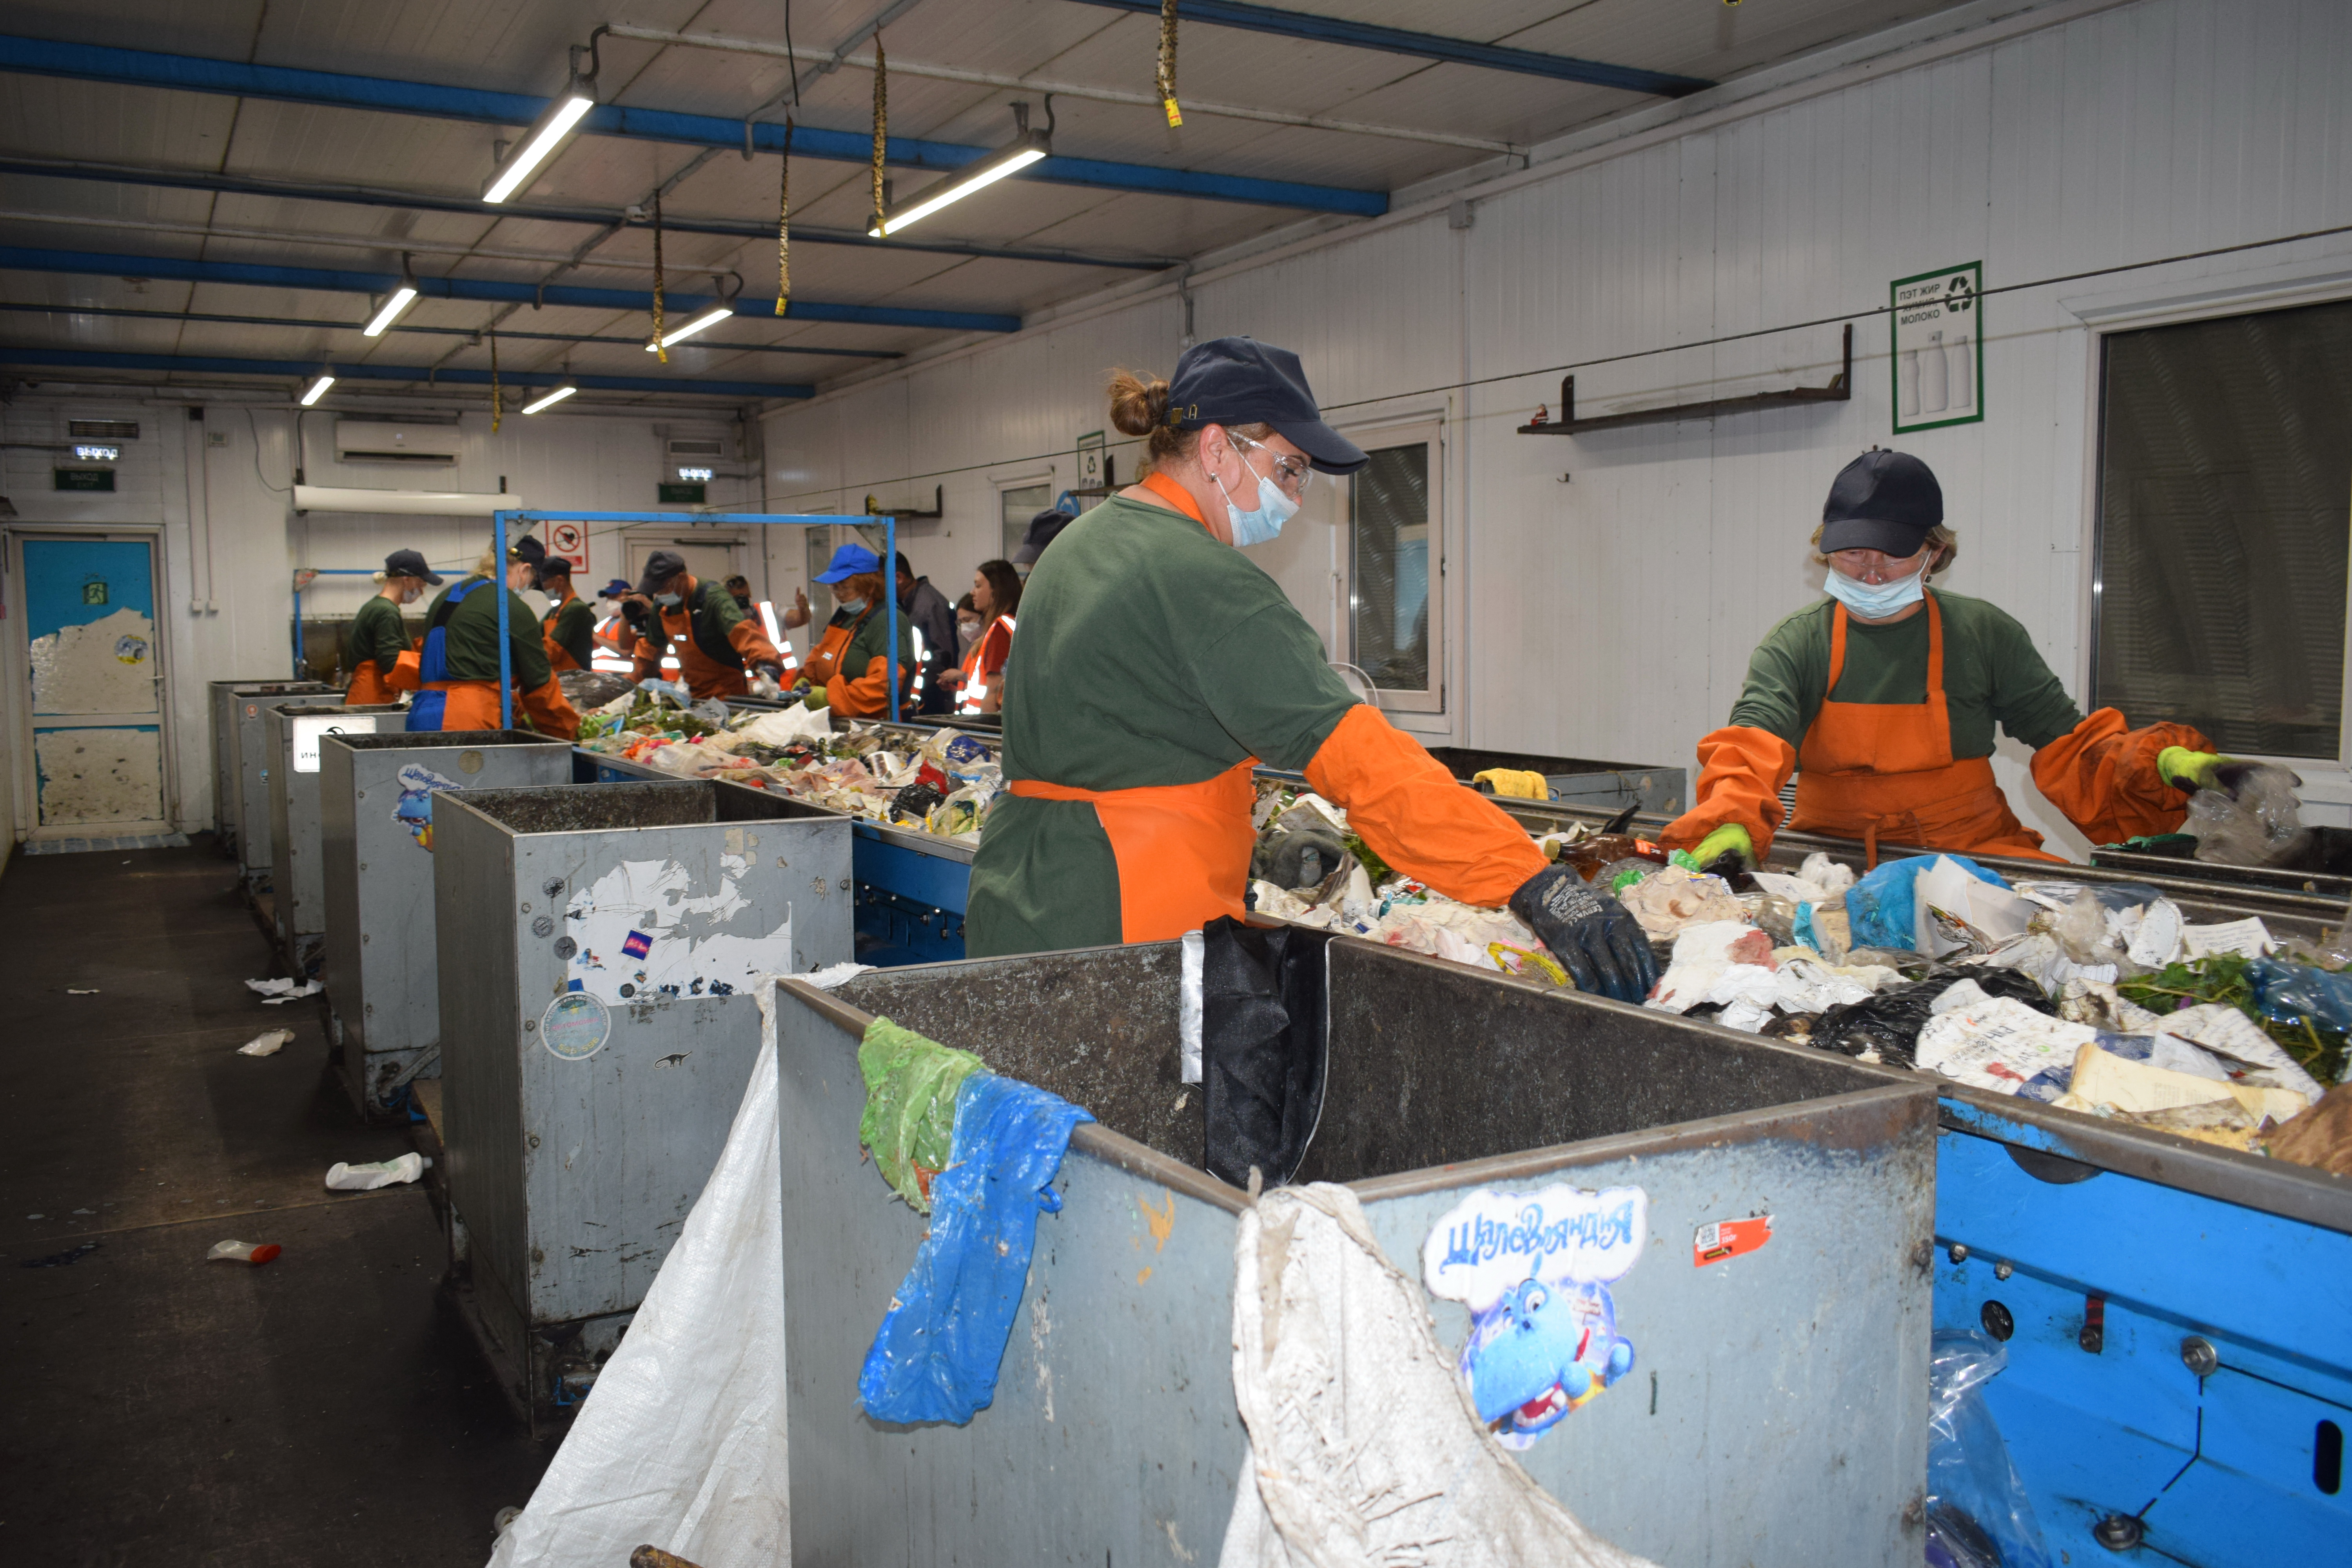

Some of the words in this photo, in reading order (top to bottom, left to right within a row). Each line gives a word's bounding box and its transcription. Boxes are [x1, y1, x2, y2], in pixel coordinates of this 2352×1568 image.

[1900, 289, 1917, 301] ПЭТ
[1920, 284, 1940, 296] ЖИР
[1901, 309, 1940, 325] МОЛОКО
[76, 447, 119, 458] ВЫХОД
